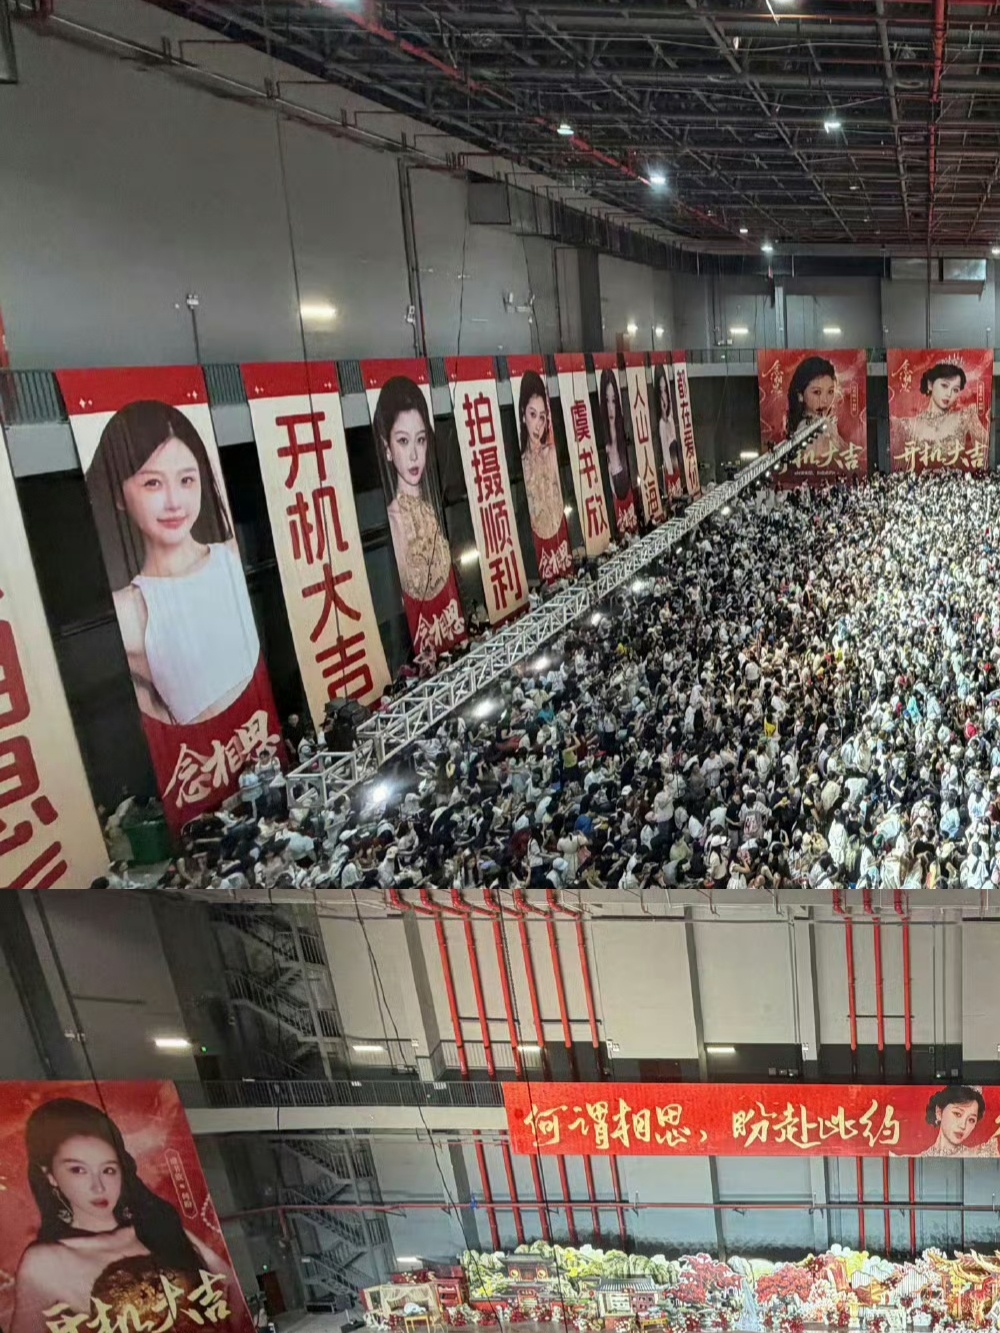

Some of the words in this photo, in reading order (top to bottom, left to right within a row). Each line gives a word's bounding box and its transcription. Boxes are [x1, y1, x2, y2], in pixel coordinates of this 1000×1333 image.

[463, 392, 523, 611] 拍摄顺利
[570, 400, 608, 539] 虞书欣
[633, 374, 659, 519] 人山人海
[779, 438, 864, 475] 机大吉
[893, 440, 989, 473] 开机大吉
[275, 411, 375, 700] 开机大吉
[162, 710, 281, 808] 念相思
